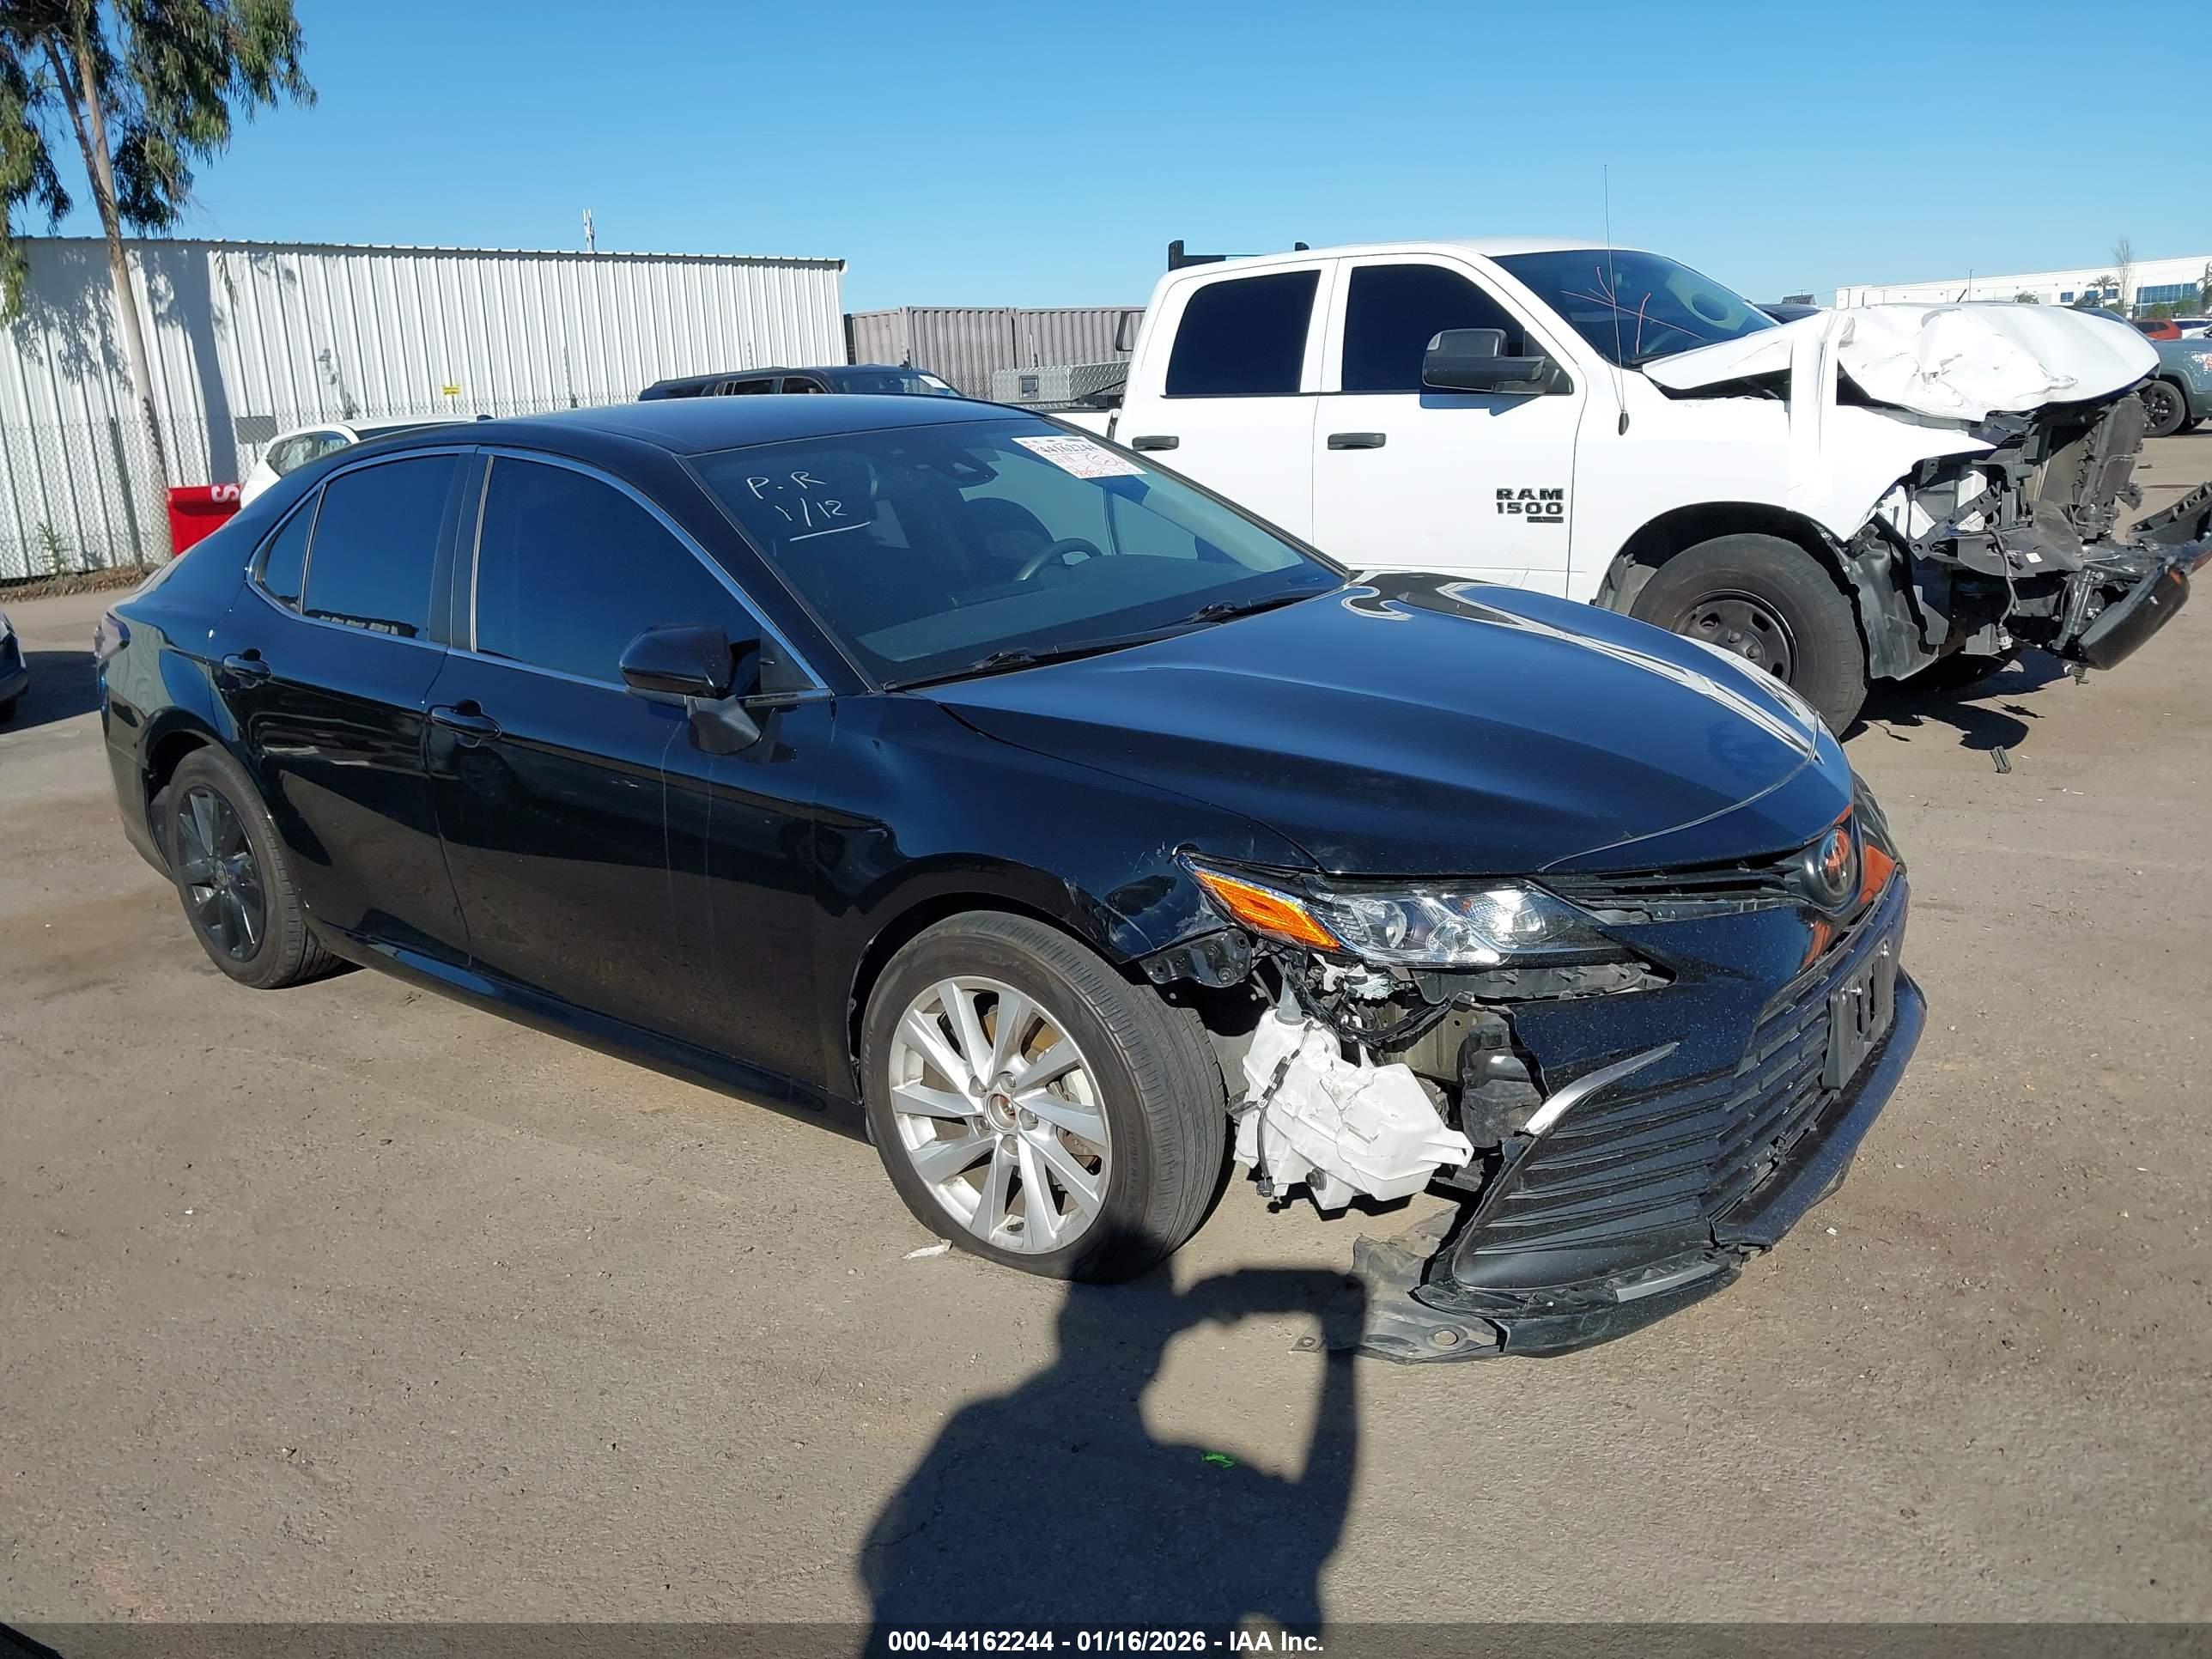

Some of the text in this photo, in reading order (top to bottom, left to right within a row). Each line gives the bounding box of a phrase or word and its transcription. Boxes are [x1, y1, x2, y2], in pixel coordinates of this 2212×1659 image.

[1497, 488, 1564, 501] RAM
[775, 497, 848, 527] 1/12
[1497, 502, 1563, 514] 1500
